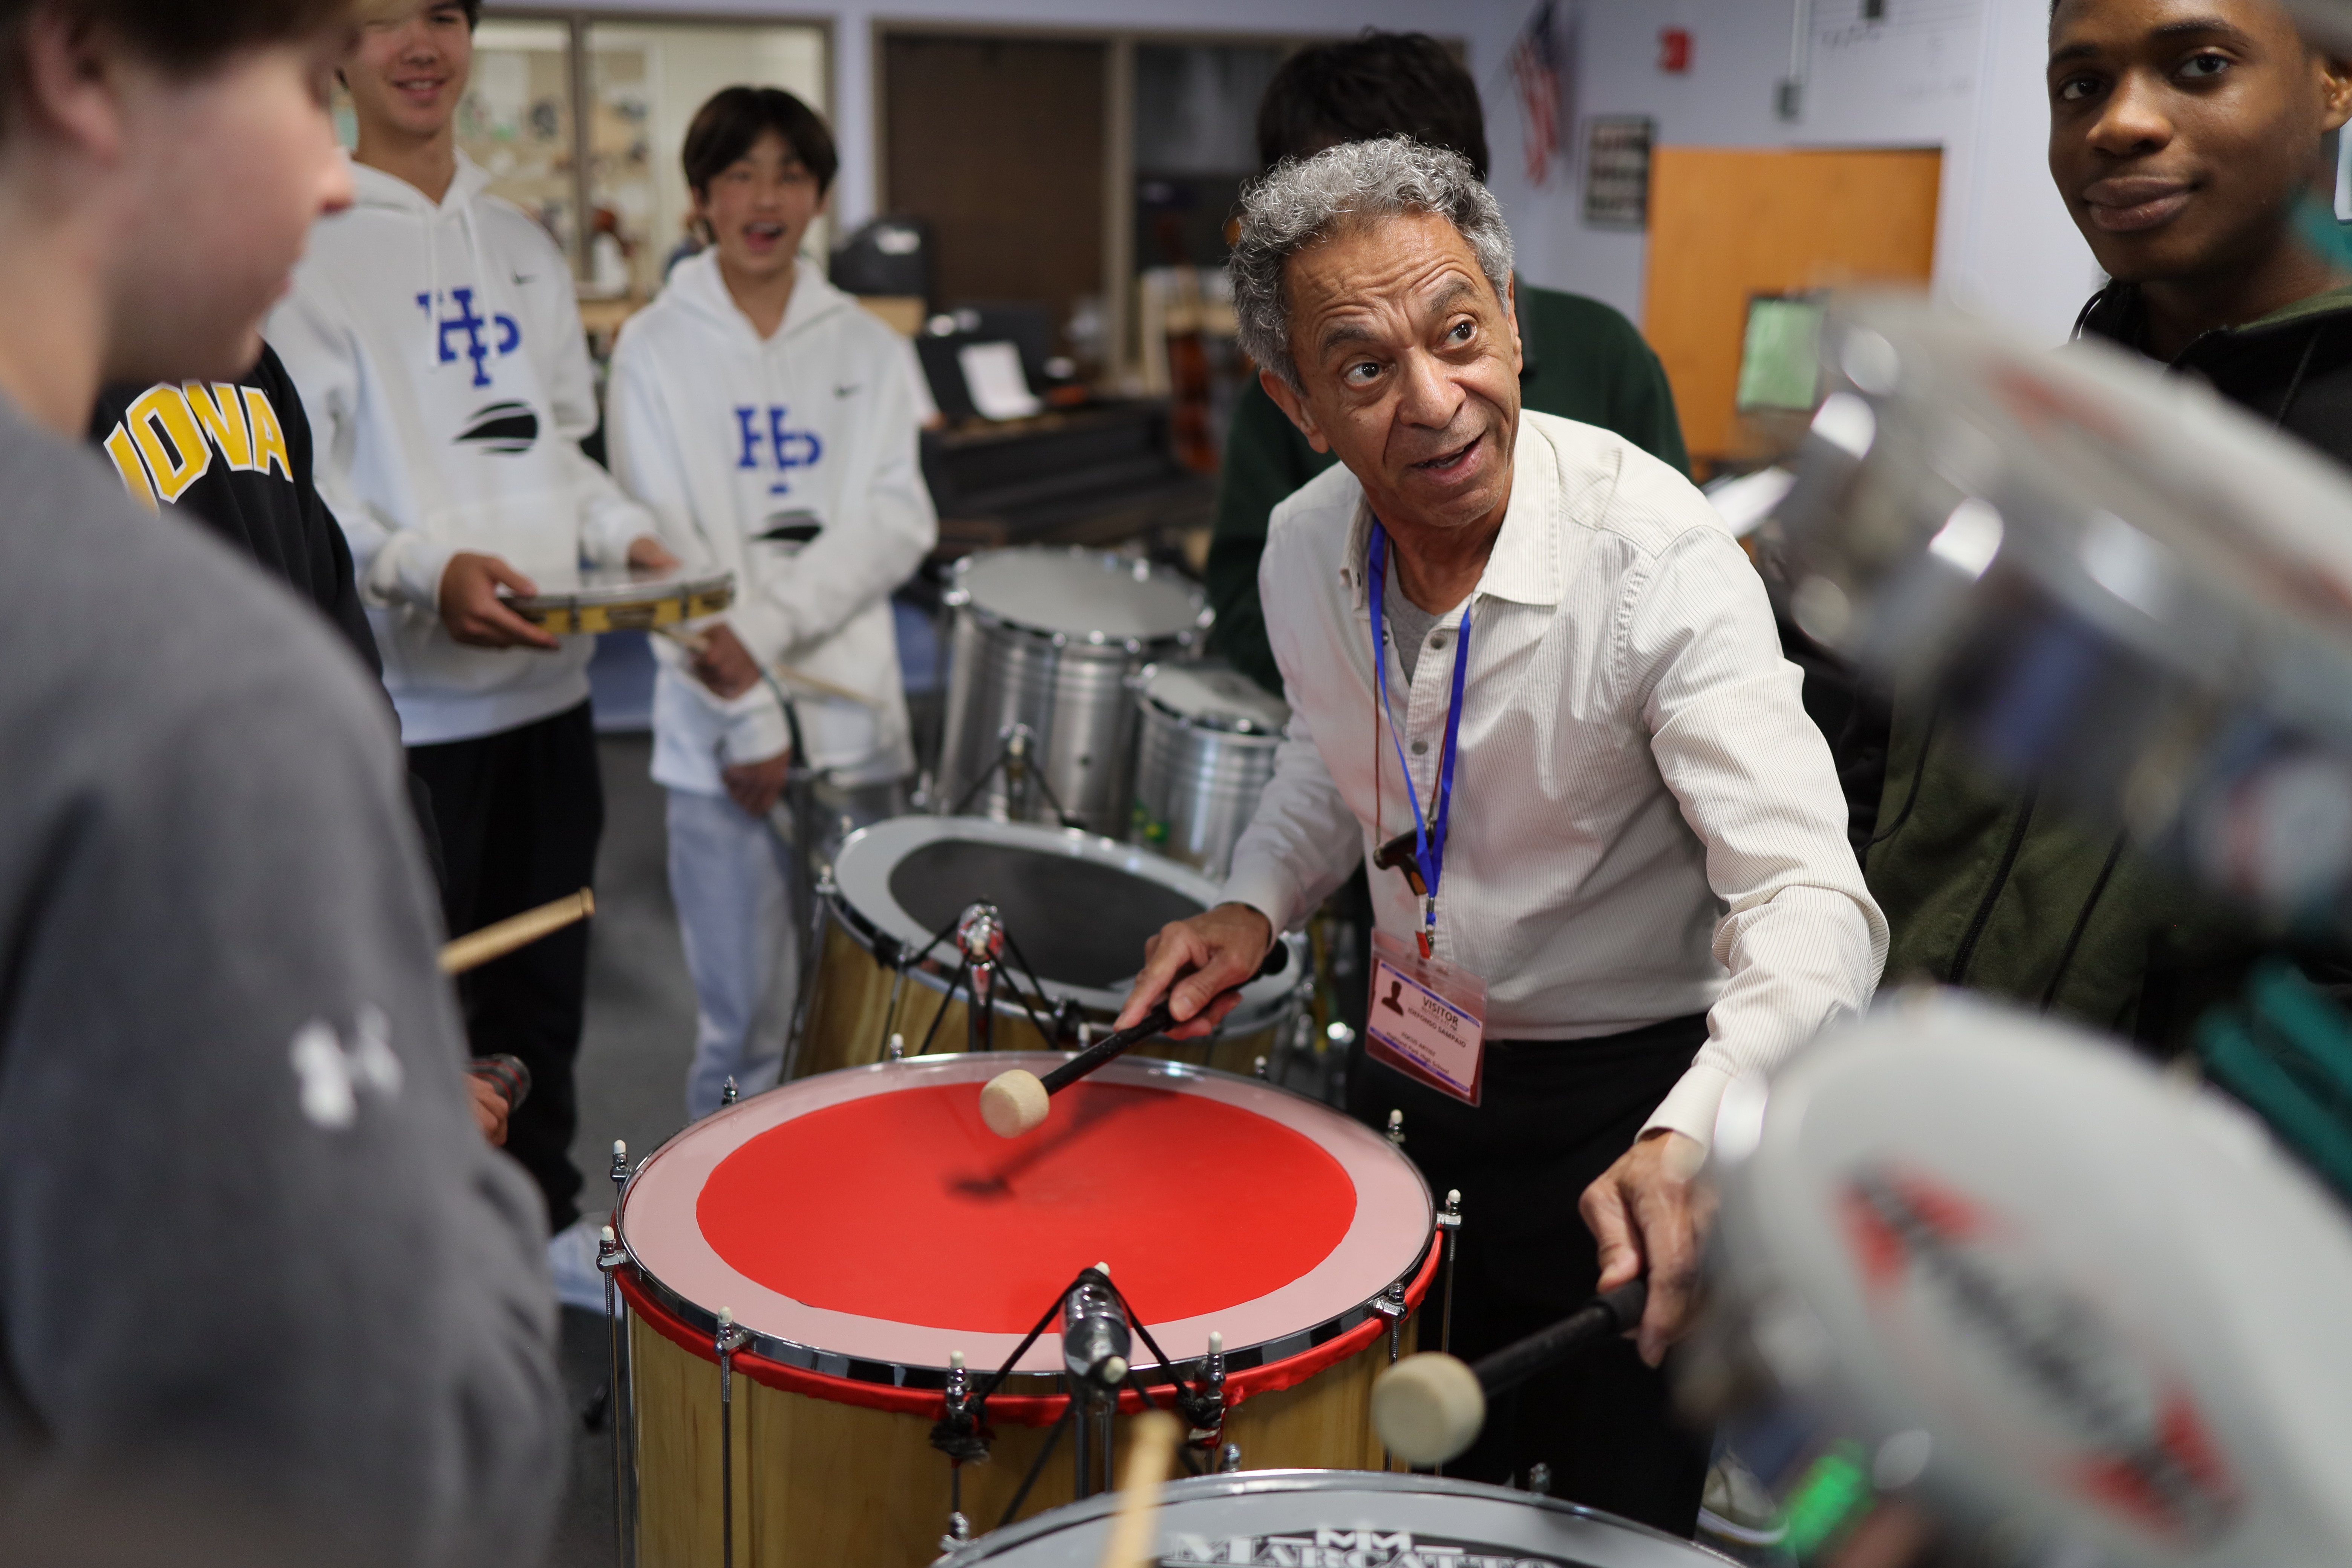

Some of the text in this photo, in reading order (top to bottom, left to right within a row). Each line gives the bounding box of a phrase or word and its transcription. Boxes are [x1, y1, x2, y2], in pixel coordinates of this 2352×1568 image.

[103, 378, 294, 518] IOWA
[1423, 995, 1458, 1026] VISITOR
[1438, 1026, 1466, 1048] SAMPAIO
